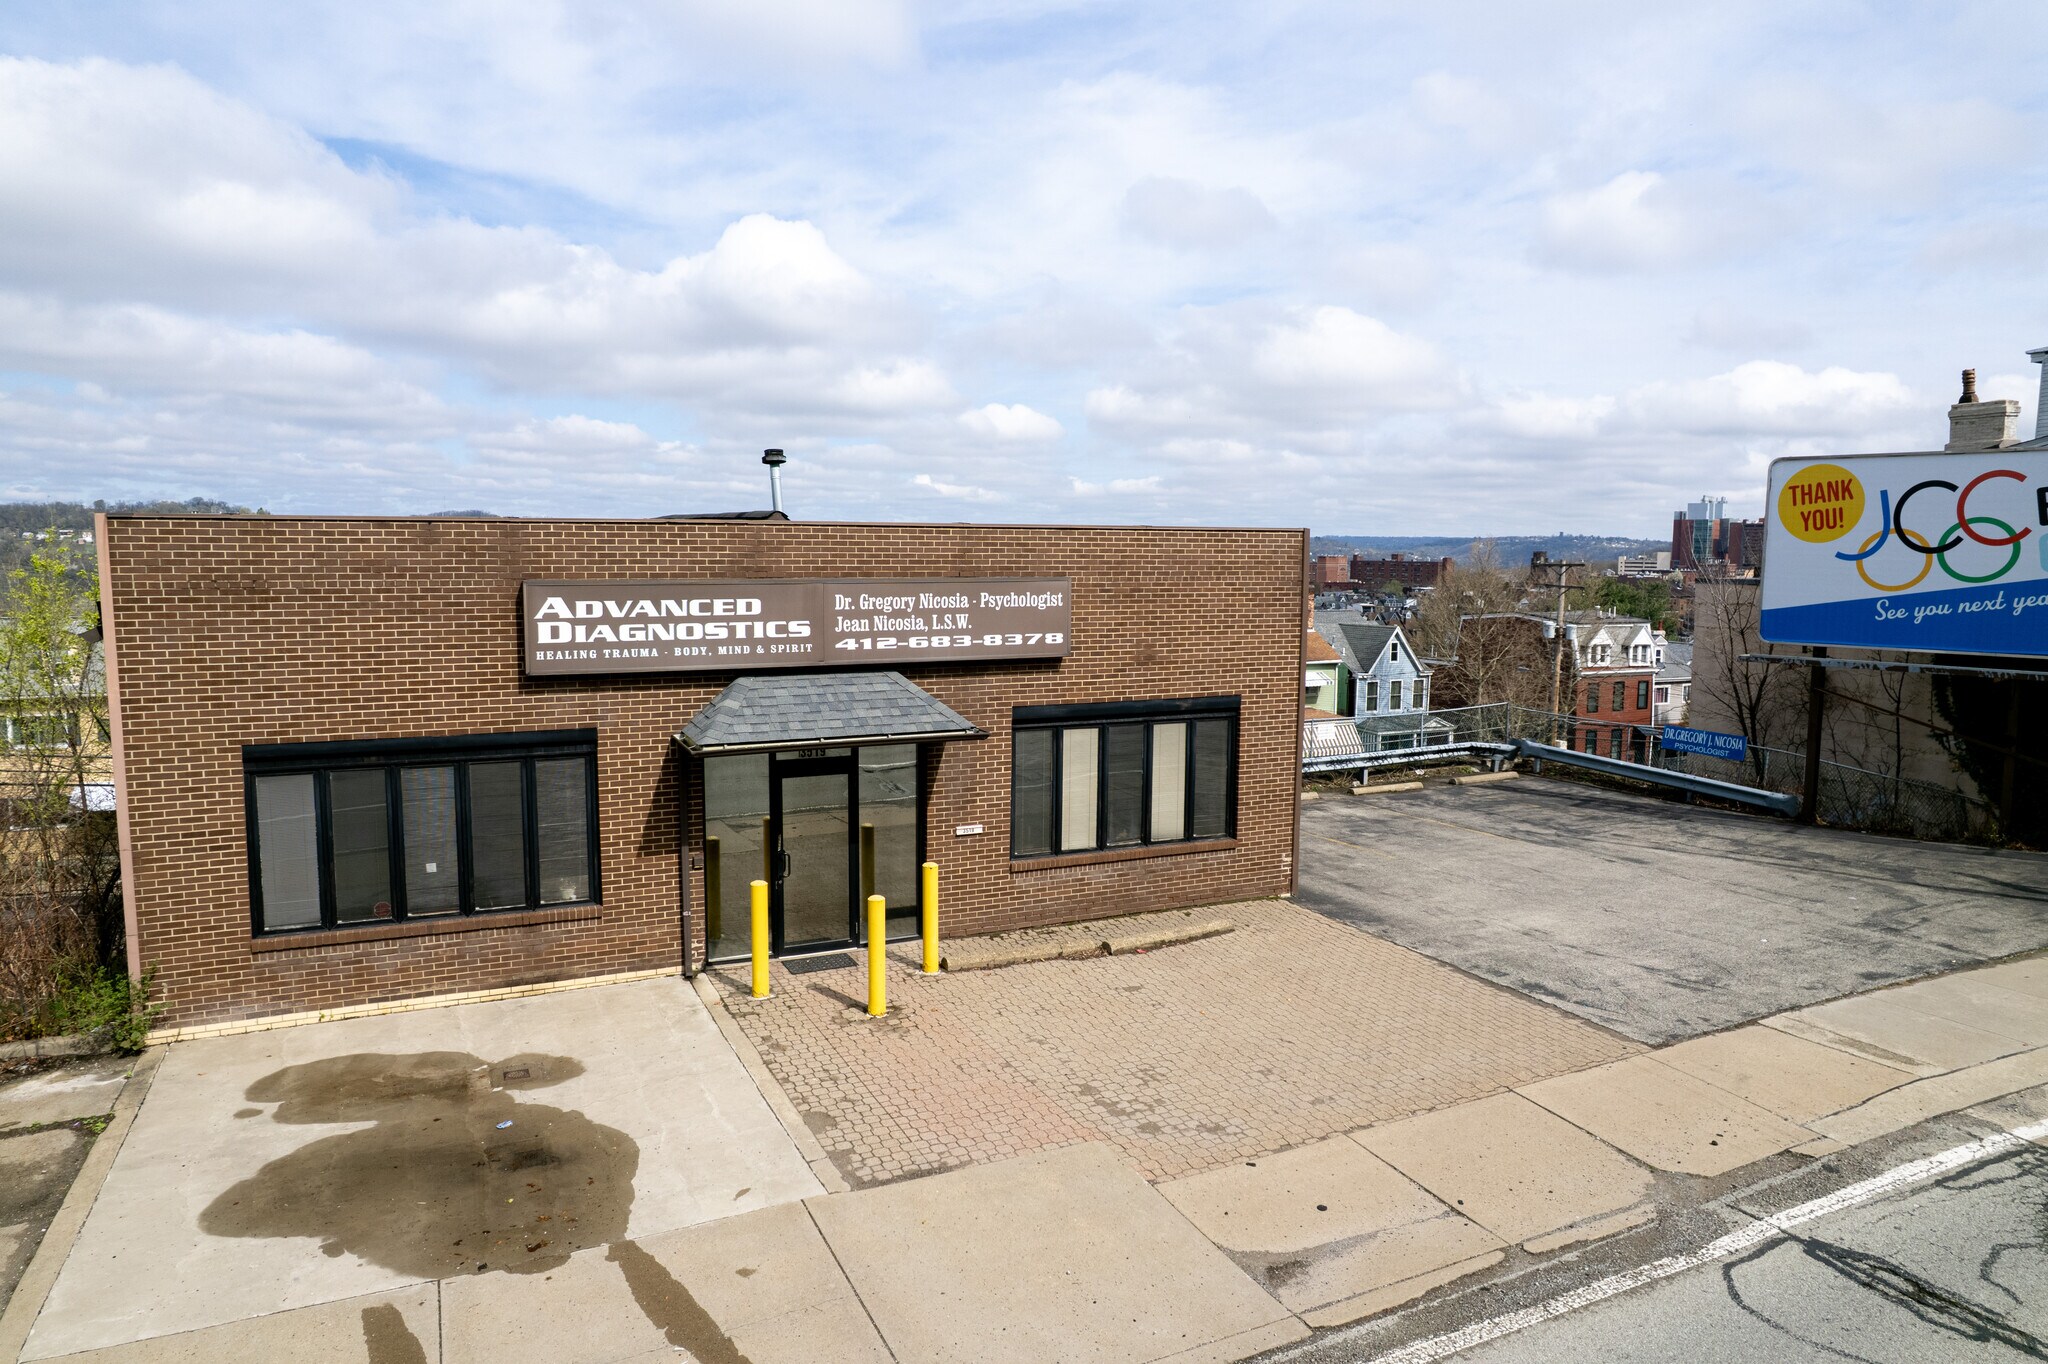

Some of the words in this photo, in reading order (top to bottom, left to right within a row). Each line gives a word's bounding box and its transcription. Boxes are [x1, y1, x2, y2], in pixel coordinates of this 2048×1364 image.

[1788, 478, 1854, 507] THANK
[1800, 506, 1845, 532] YOU!
[834, 594, 855, 611] Dr.
[859, 593, 915, 613] Gregory
[918, 592, 969, 610] Nicosia
[979, 591, 1063, 611] Psychologist
[1875, 599, 1909, 621] See
[1913, 605, 1953, 624] you
[1957, 590, 2006, 615] next
[834, 615, 870, 632] Jean
[873, 615, 928, 632] Nicosia,
[932, 613, 972, 630] L.S.W.
[834, 632, 1064, 650] 412-683-8378
[536, 650, 598, 661] HEALING
[603, 648, 659, 659] TRAUMA
[674, 646, 712, 657] BODY,
[718, 645, 750, 655] MIND
[756, 644, 765, 654] &
[770, 643, 813, 654] SPIRIT
[1674, 742, 1730, 757] PSYCHOLOGIST
[1714, 735, 1743, 751] NICOSIA
